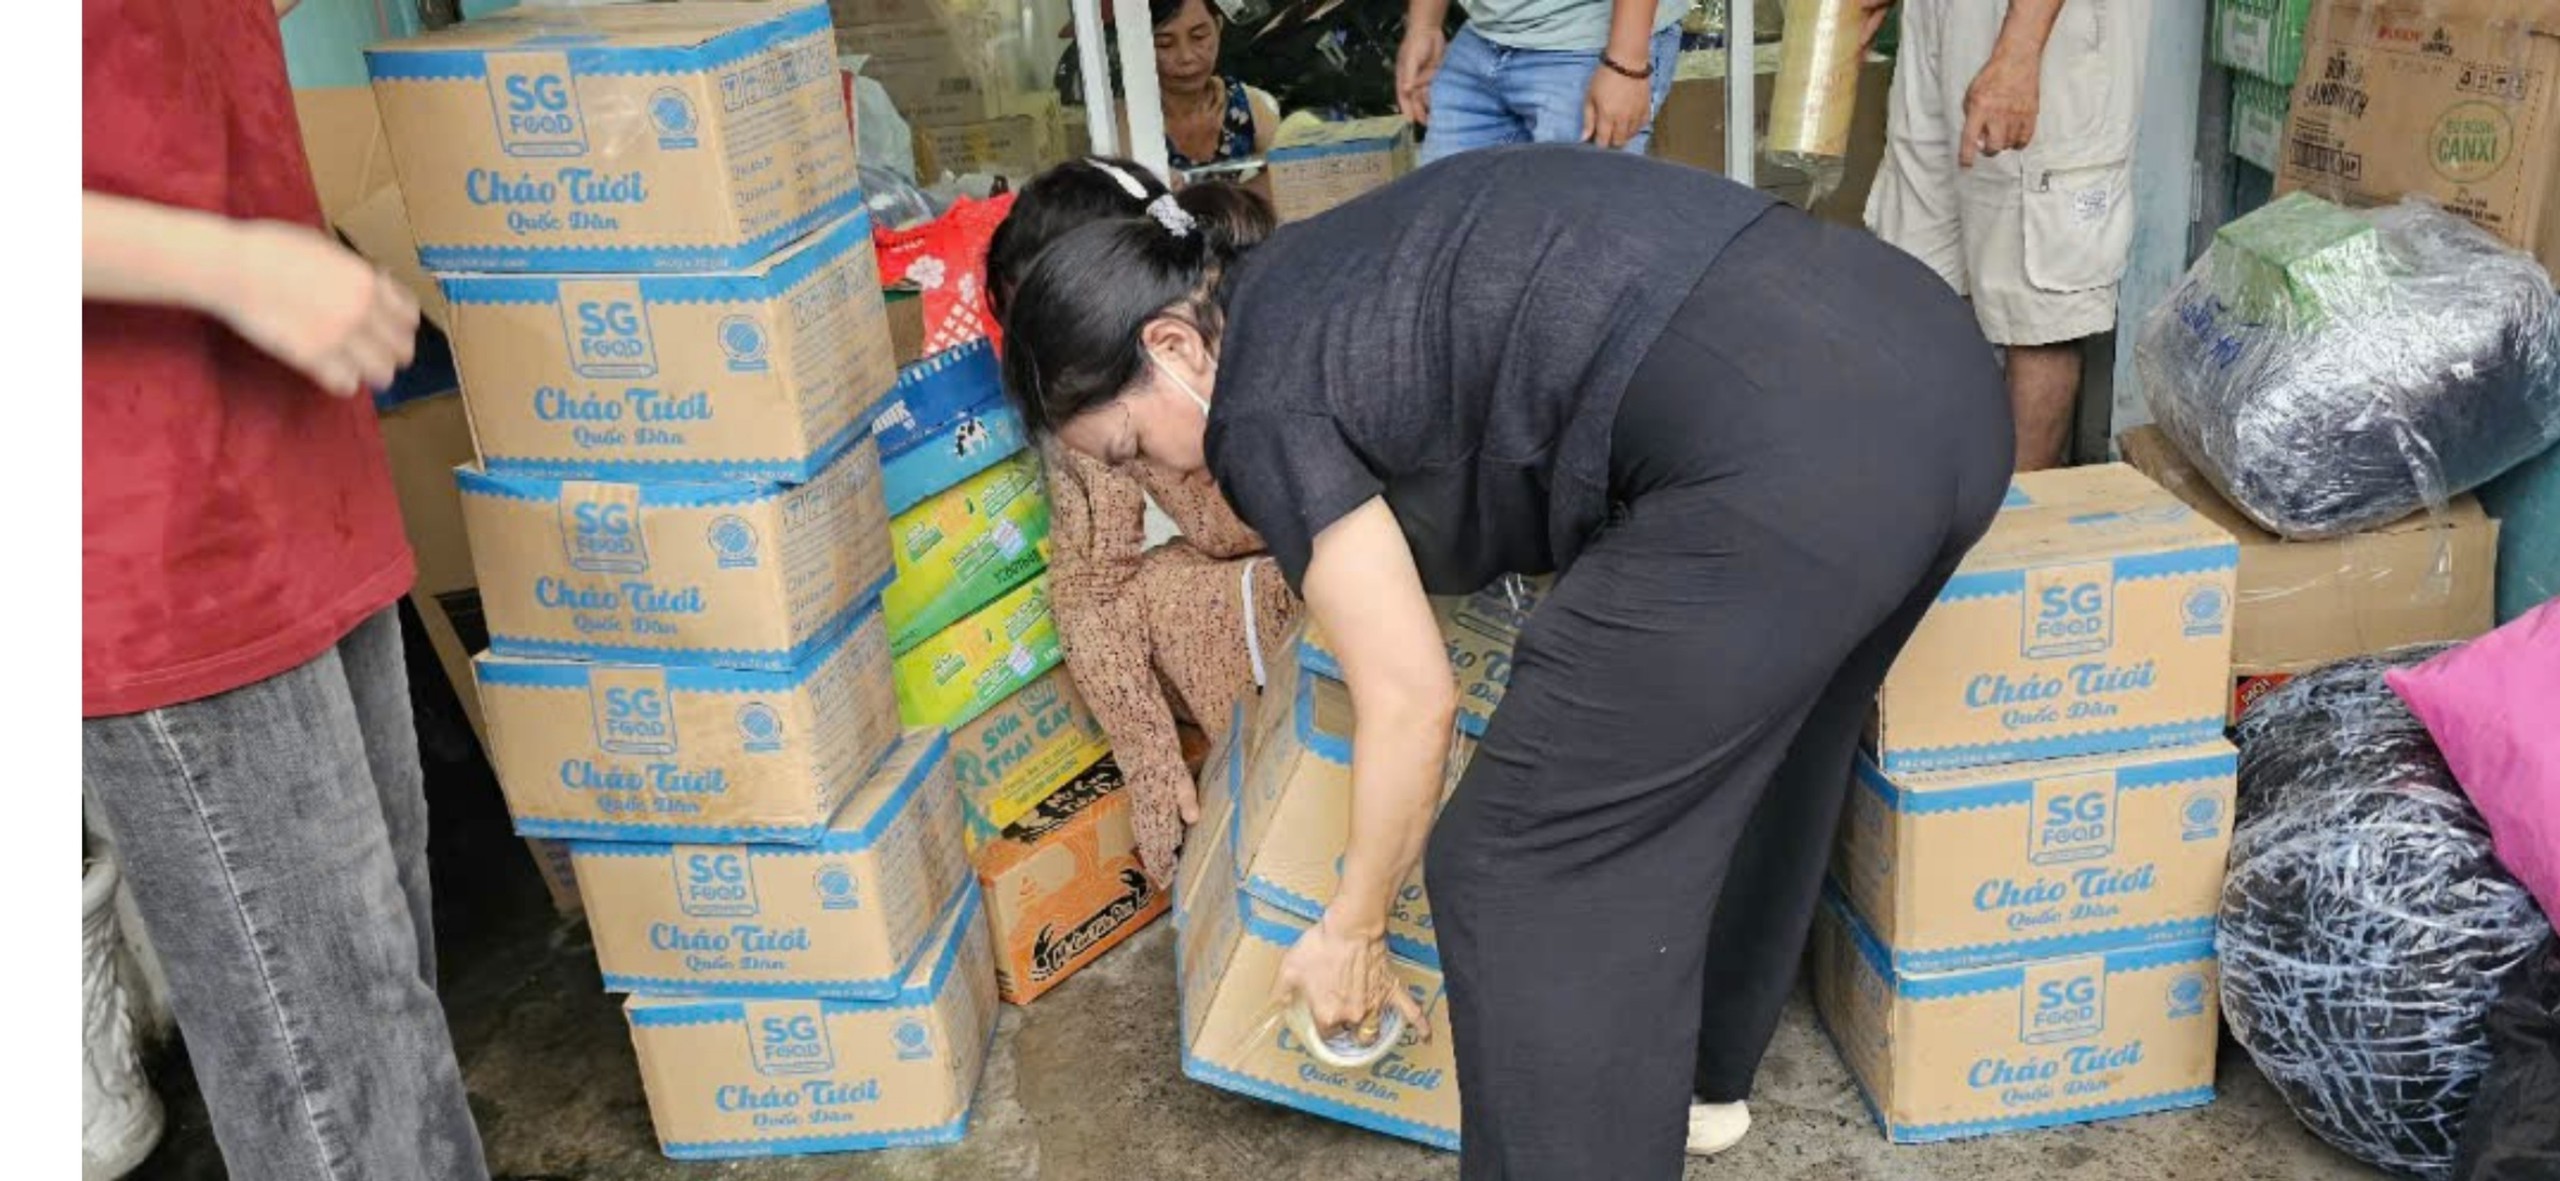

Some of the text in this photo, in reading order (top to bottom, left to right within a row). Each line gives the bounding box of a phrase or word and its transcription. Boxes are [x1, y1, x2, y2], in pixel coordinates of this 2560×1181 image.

[505, 74, 568, 112] SG
[509, 114, 574, 134] FOOD
[2438, 136, 2497, 163] CANXI
[466, 167, 648, 205] Cháo Tươi
[507, 209, 562, 236] Quốc
[578, 301, 639, 336] SG
[581, 338, 644, 358] FOOD
[534, 386, 713, 421] Cháo Tươi
[572, 425, 626, 448] Quốc
[574, 502, 630, 536] SG
[576, 536, 634, 553] FOOD
[535, 575, 706, 614] Cháo Tươi
[2039, 583, 2102, 618] SG
[2036, 617, 2101, 638] FOOD
[1965, 660, 2156, 708] Cháo Tươi
[605, 688, 661, 719] SG
[2001, 701, 2118, 731] Quốc Dân
[605, 719, 665, 737] FOOD
[560, 759, 729, 794] Cháo Tươi
[2046, 791, 2106, 826] SG
[2042, 824, 2104, 846] FOOD
[688, 854, 743, 883] SG
[689, 884, 746, 901] FOOD
[1973, 863, 2155, 912] Cháo Tươi
[2007, 906, 2061, 931] Quốc
[649, 922, 811, 951] Cháo Tươi
[2038, 976, 2096, 1009] SG
[762, 1016, 818, 1044] SG
[2034, 1007, 2094, 1028] FOOD
[764, 1043, 822, 1060] FOOD
[1968, 1040, 2144, 1088] Cháo Tươi
[1299, 1061, 1348, 1088] Quốc
[1371, 1052, 1443, 1091] Tươi
[715, 1078, 882, 1112] Cháo Tươi
